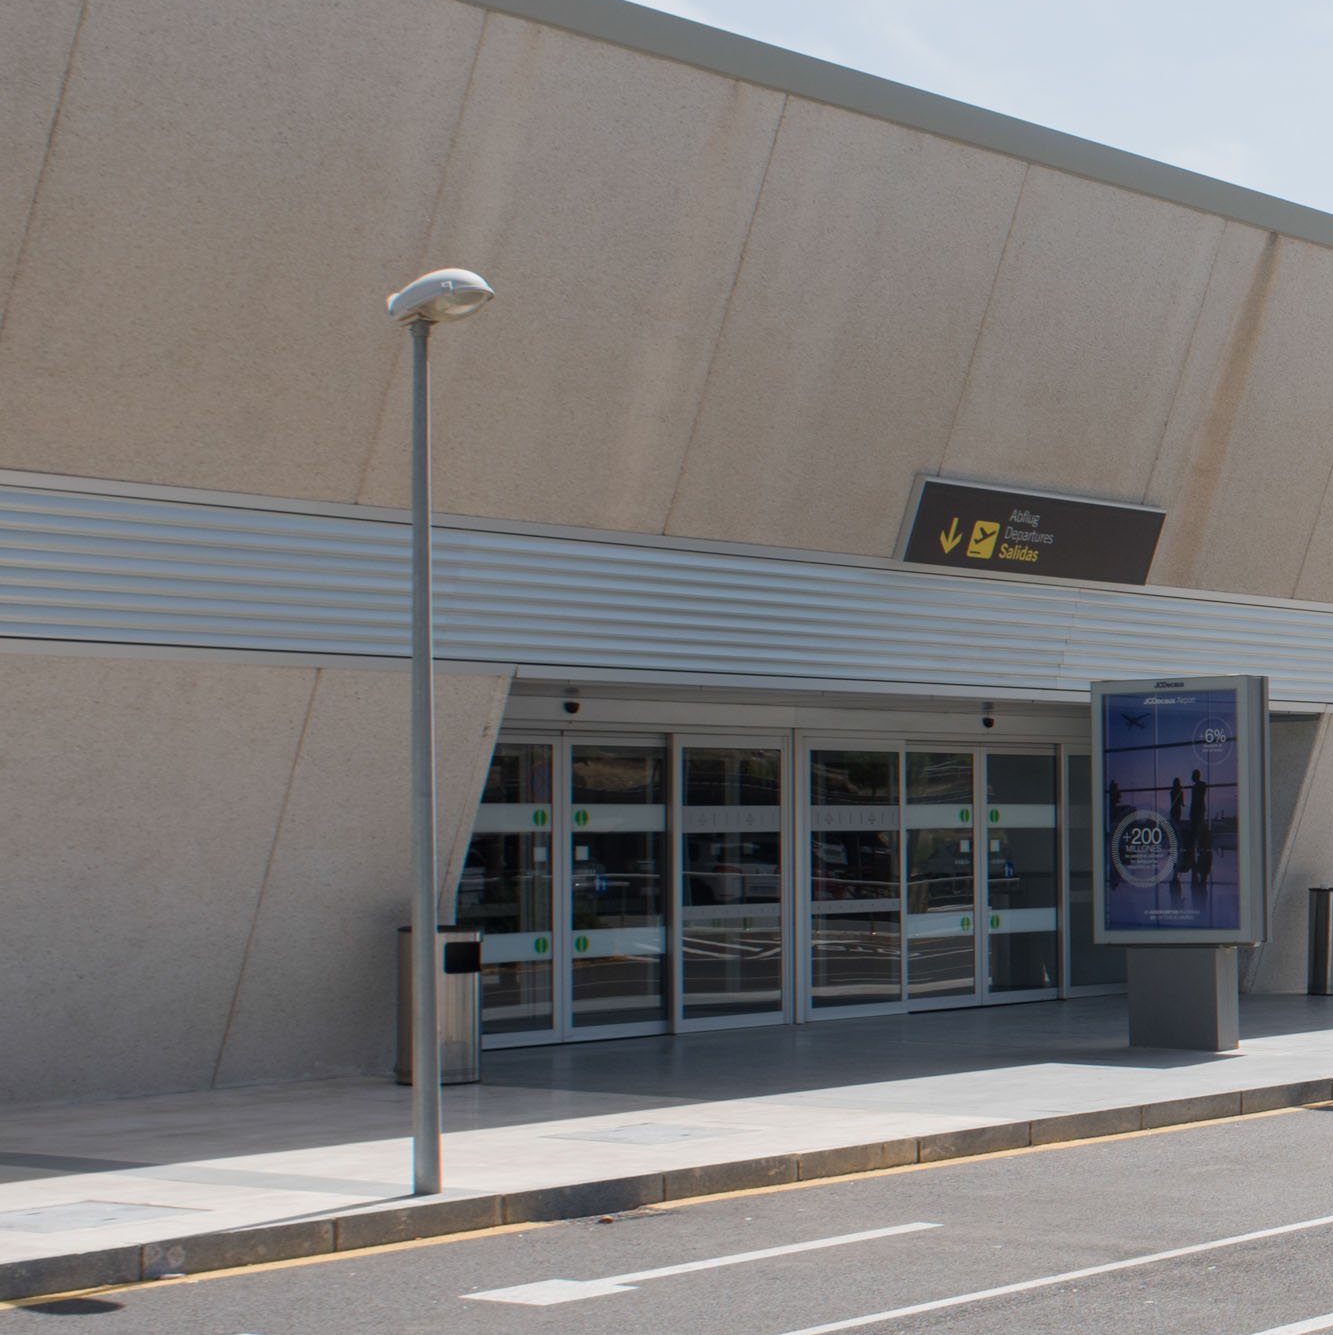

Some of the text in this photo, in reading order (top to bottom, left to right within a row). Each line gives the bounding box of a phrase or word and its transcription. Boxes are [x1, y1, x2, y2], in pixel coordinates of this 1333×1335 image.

[1009, 509, 1040, 527] Abflug
[1004, 526, 1055, 544] Departures
[998, 544, 1039, 562] Salidas
[1123, 827, 1162, 845] +200
